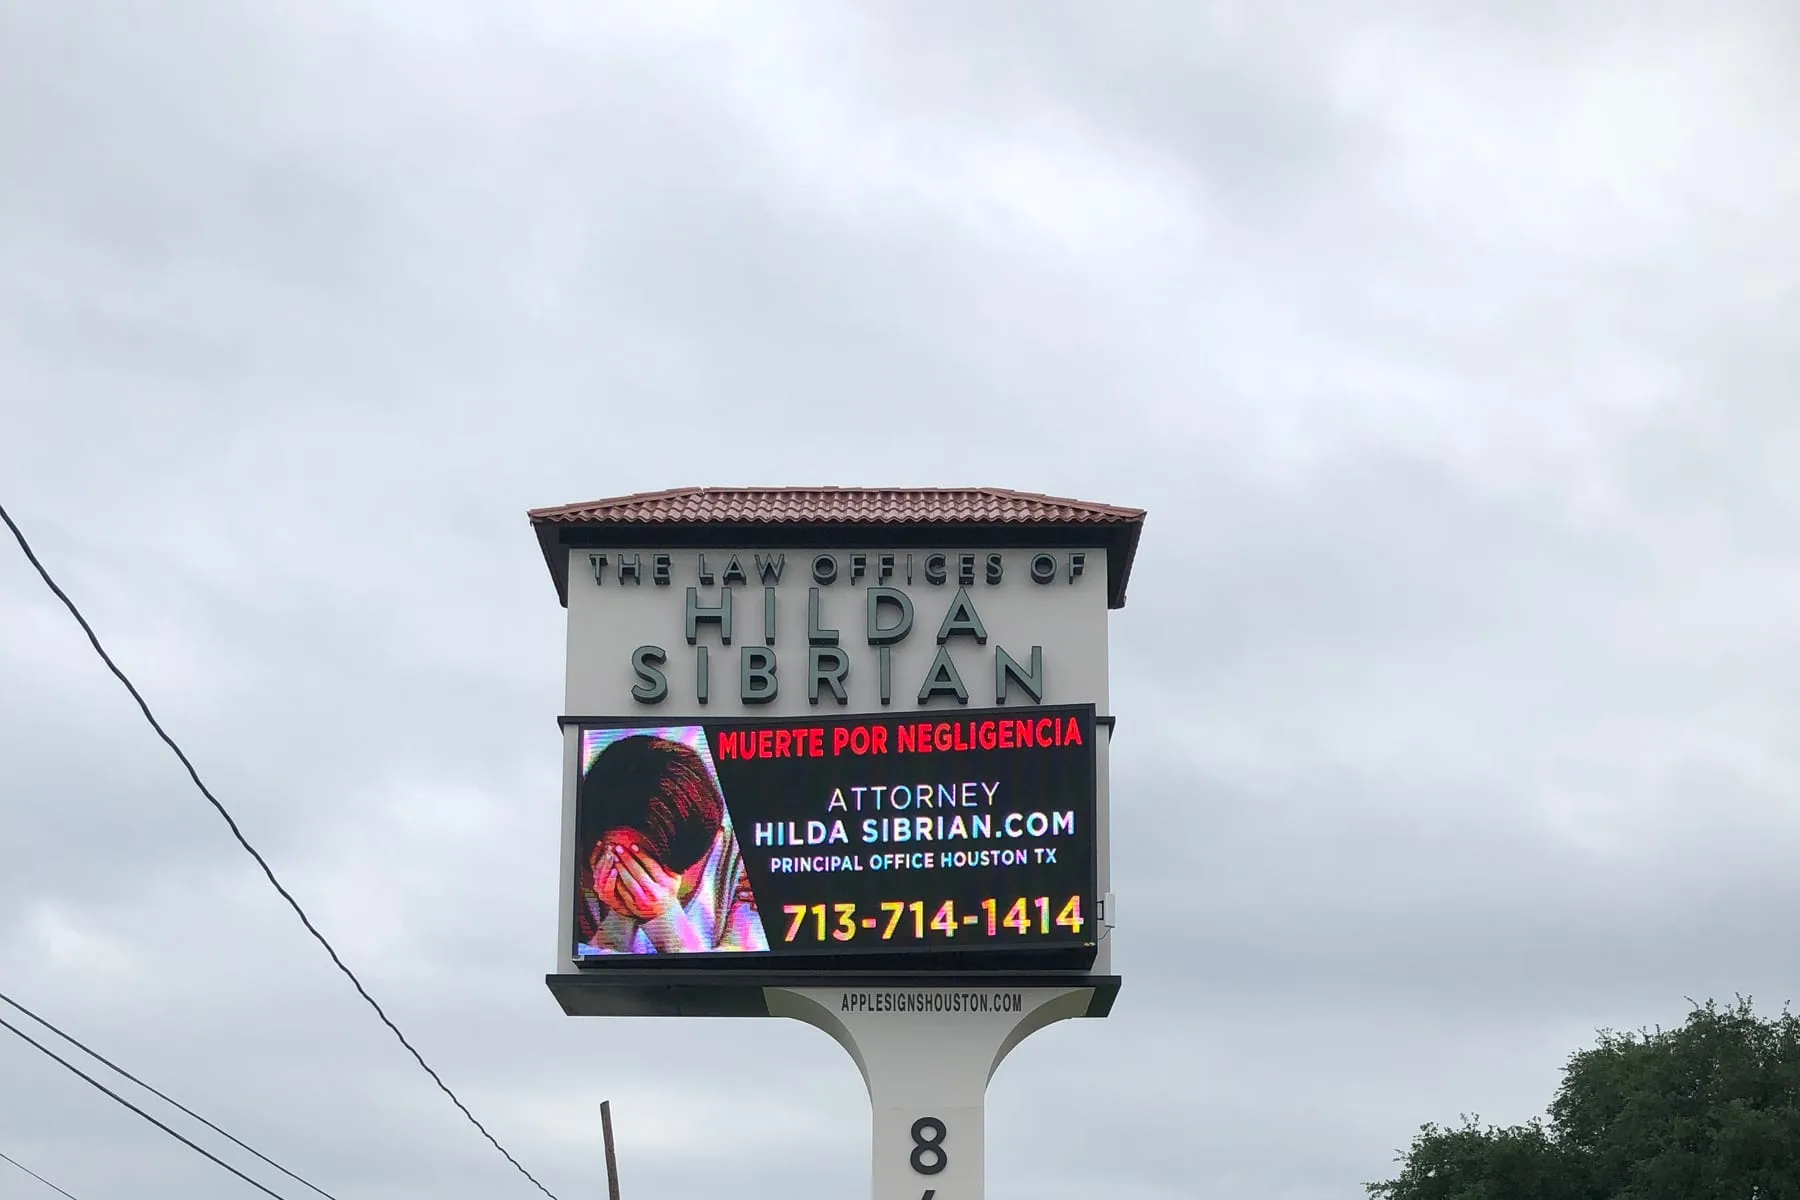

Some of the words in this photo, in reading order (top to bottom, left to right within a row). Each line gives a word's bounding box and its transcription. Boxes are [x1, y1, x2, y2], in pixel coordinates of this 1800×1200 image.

[589, 553, 672, 586] THE
[699, 553, 786, 586] LAW
[811, 553, 1004, 586] OFFICES
[1030, 552, 1086, 585] OF
[685, 586, 988, 646] HILDA
[631, 645, 1043, 705] SIBRIAN
[718, 728, 825, 761] MUERTE
[833, 725, 888, 757] POR
[897, 716, 1083, 754] NEGLIGENCIA
[827, 781, 1001, 813] ATTORNEY
[754, 819, 850, 847] HILDA
[861, 810, 1076, 844] SIBRIAN.COM
[771, 855, 864, 873] PRINCIPAL
[869, 852, 935, 870] OFFICE
[940, 849, 1028, 868] HOUSTON
[1034, 847, 1057, 864] TX
[783, 895, 1085, 942] 713-714-1414
[841, 993, 1022, 1012] APPLESIGNSHOUSTON.COM
